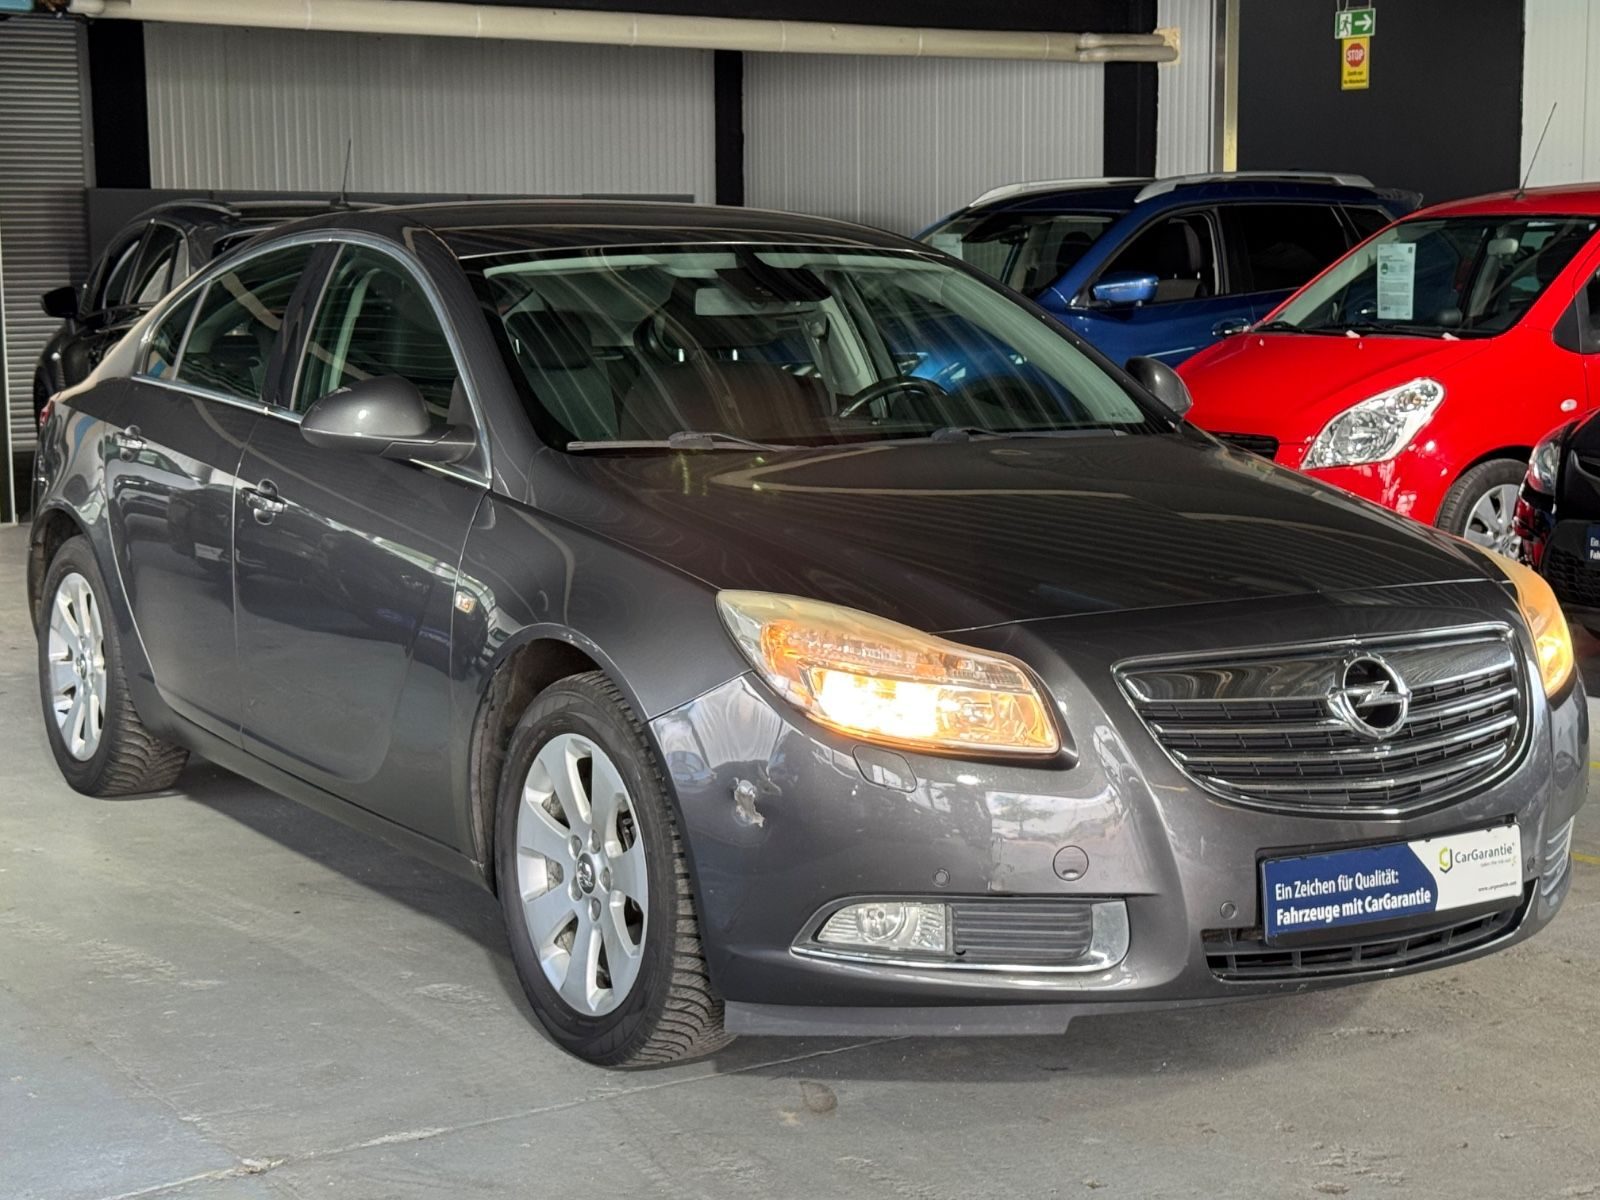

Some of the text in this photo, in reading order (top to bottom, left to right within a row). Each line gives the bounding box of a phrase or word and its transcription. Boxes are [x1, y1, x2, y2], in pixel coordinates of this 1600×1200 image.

[1347, 49, 1364, 61] STOP
[1275, 868, 1399, 901] Ein Zeichen für Qualität:
[1276, 887, 1432, 926] Fahrzeuge mit CarGarantie
